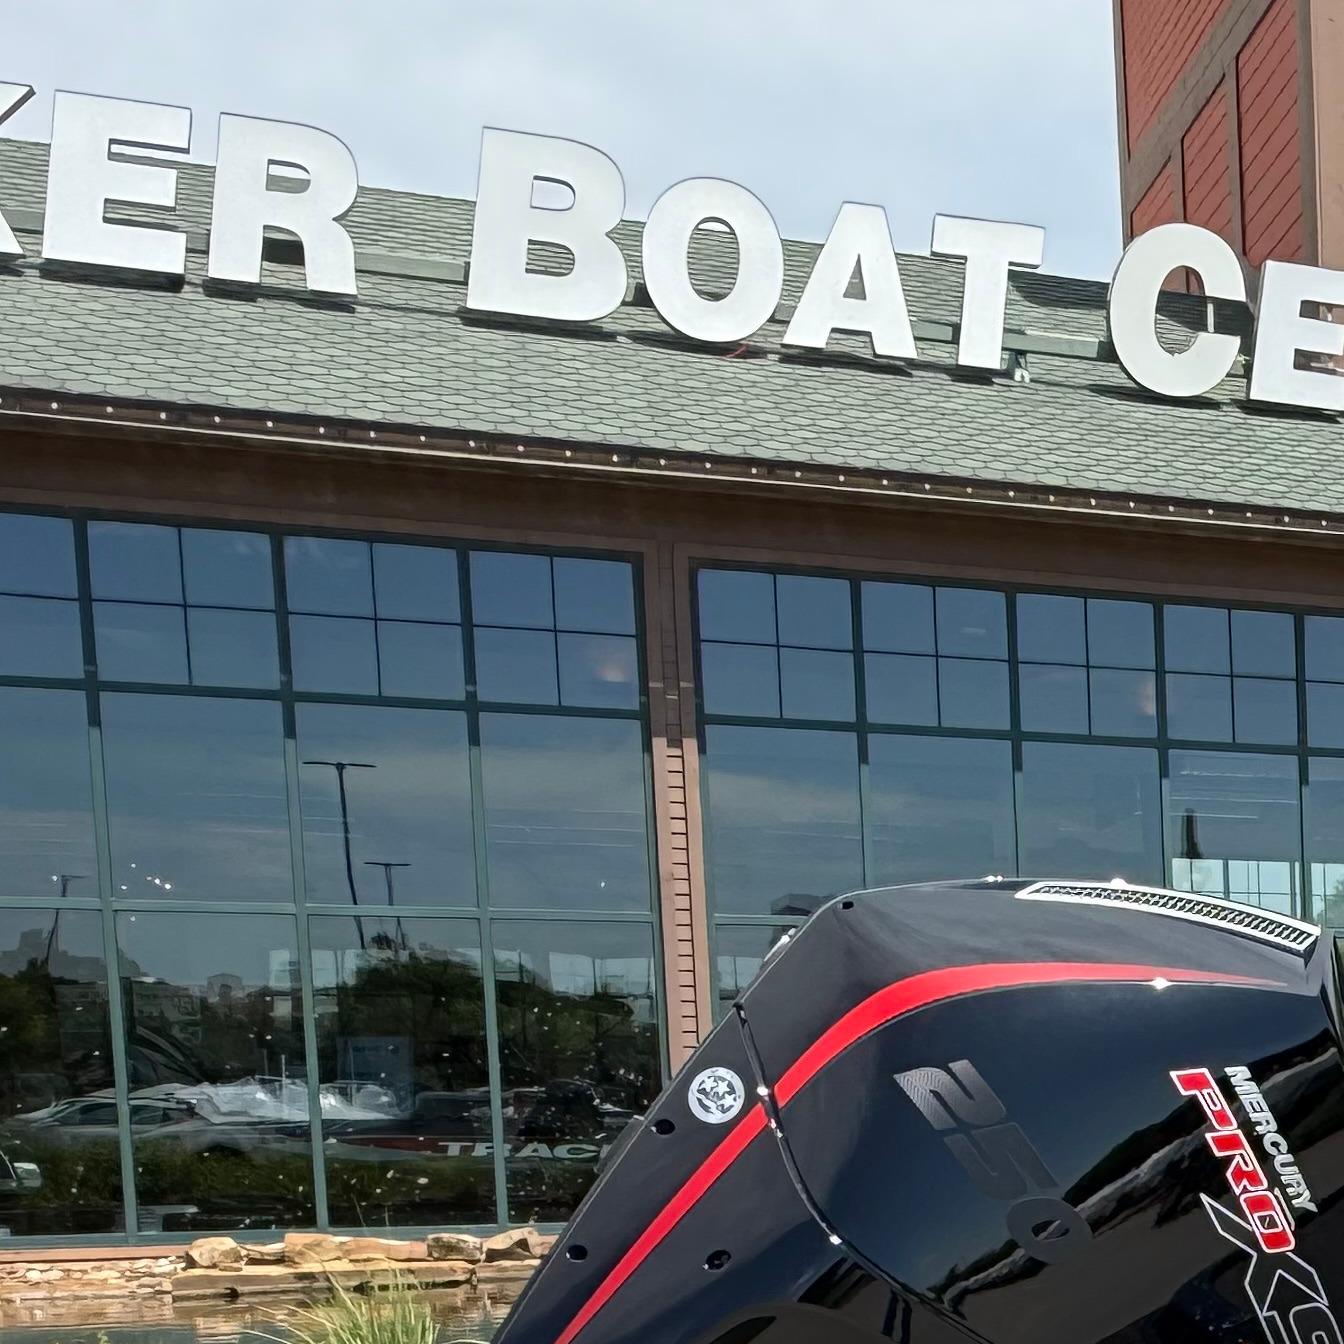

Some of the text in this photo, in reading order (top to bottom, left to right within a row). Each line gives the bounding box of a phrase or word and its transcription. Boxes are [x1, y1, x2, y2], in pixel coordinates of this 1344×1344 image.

[466, 126, 1045, 372] BOAT
[438, 1141, 612, 1158] TRAC
[1169, 1067, 1296, 1254] PRO
[1224, 1066, 1319, 1214] MERCURY
